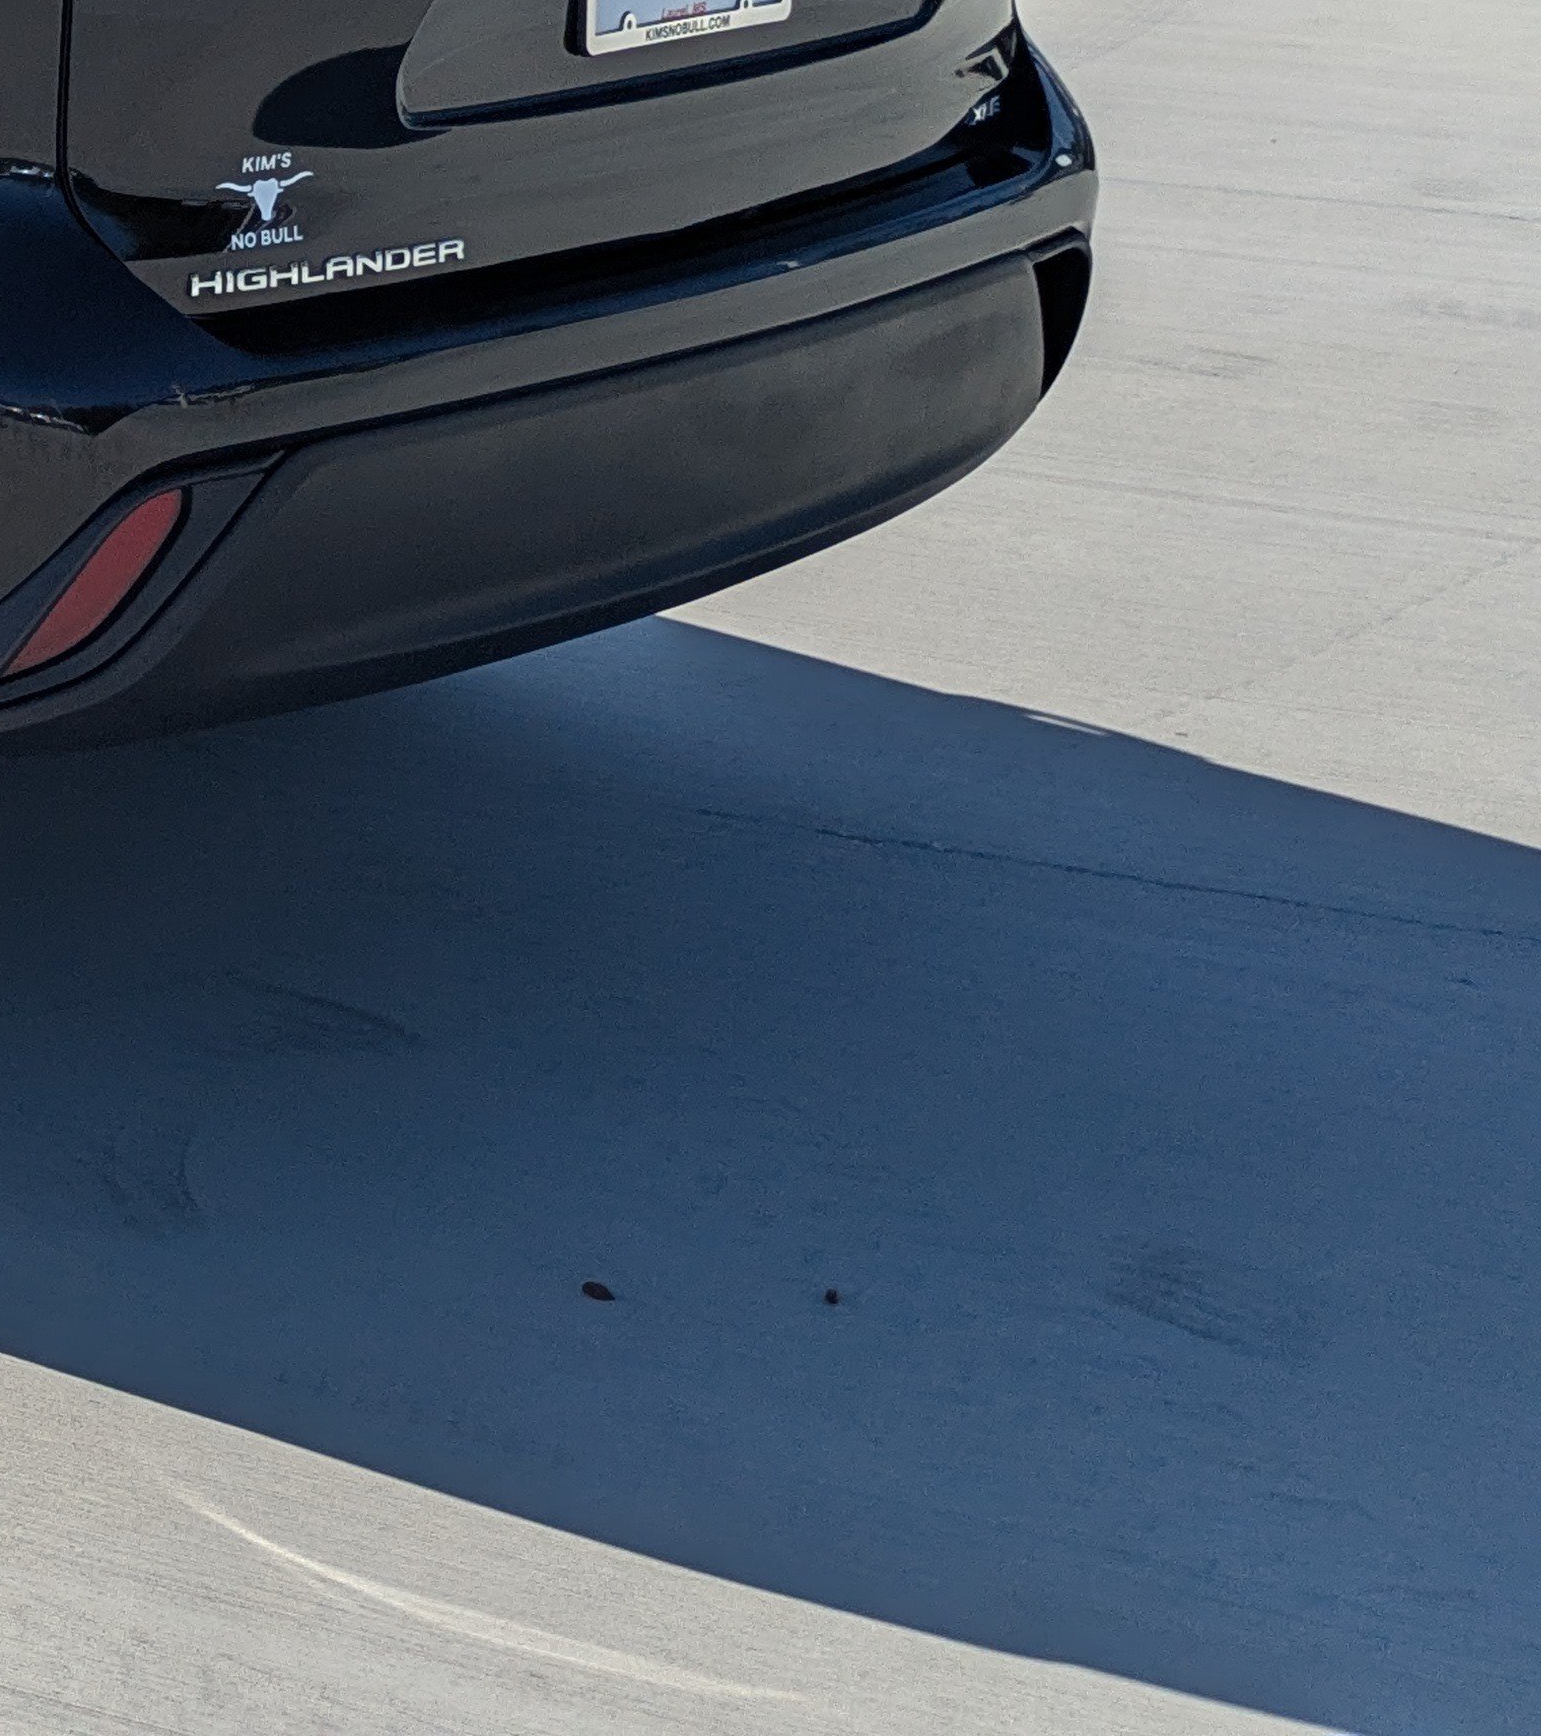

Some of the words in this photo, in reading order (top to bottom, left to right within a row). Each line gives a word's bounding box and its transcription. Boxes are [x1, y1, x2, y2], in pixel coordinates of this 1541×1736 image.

[645, 15, 731, 41] KIMSNOBULL.COM
[242, 152, 292, 173] KIM'S
[231, 231, 257, 250] NO
[261, 225, 304, 246] BULL
[190, 239, 466, 297] HIGHLANDER
